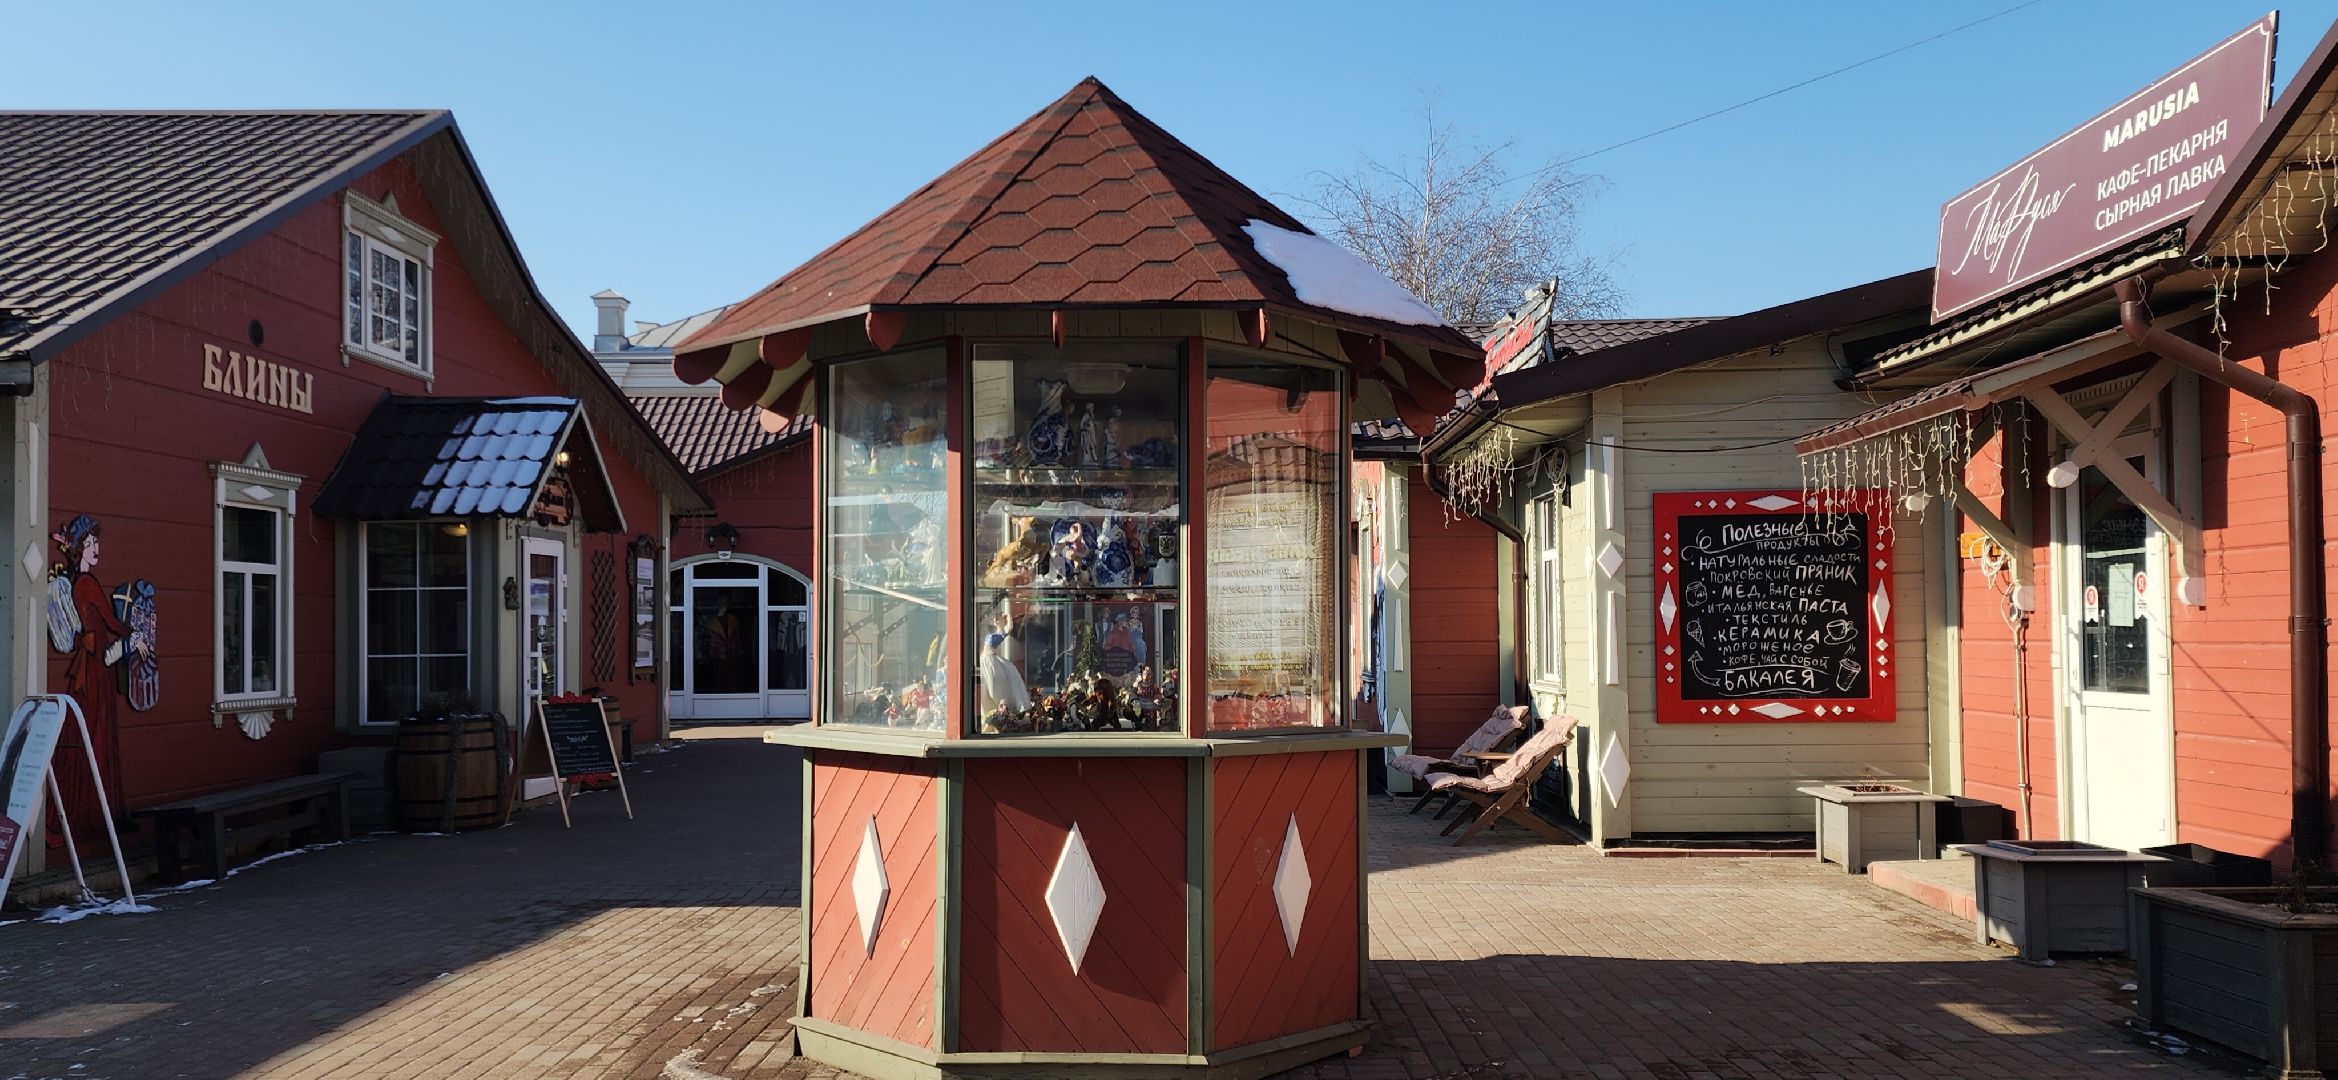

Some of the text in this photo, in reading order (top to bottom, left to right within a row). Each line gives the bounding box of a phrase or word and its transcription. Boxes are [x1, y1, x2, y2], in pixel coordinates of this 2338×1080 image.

[2103, 81, 2199, 152] MARUSIA
[2097, 118, 2228, 201] КАФЕ-ПЕКАРНЯ
[2096, 154, 2226, 231] СЫРНАЯ ЛАВКА
[203, 343, 314, 415] БЛИНЫ
[1700, 554, 1799, 571] НАТУРАЛЬНЫЕ
[1710, 565, 1858, 585] ПОКРОВСКИЙ ПРЯНИК
[1769, 583, 1825, 599] ВАРЕНЬЕ
[1708, 598, 1849, 615] ИТАЛЬЯНСКАЯ ПАСТА
[1733, 614, 1808, 626] ТЕКСТИЛЬ
[1718, 627, 1820, 645] КЕРАМИКА
[1725, 669, 1815, 691] БАКАЛЕЯ
